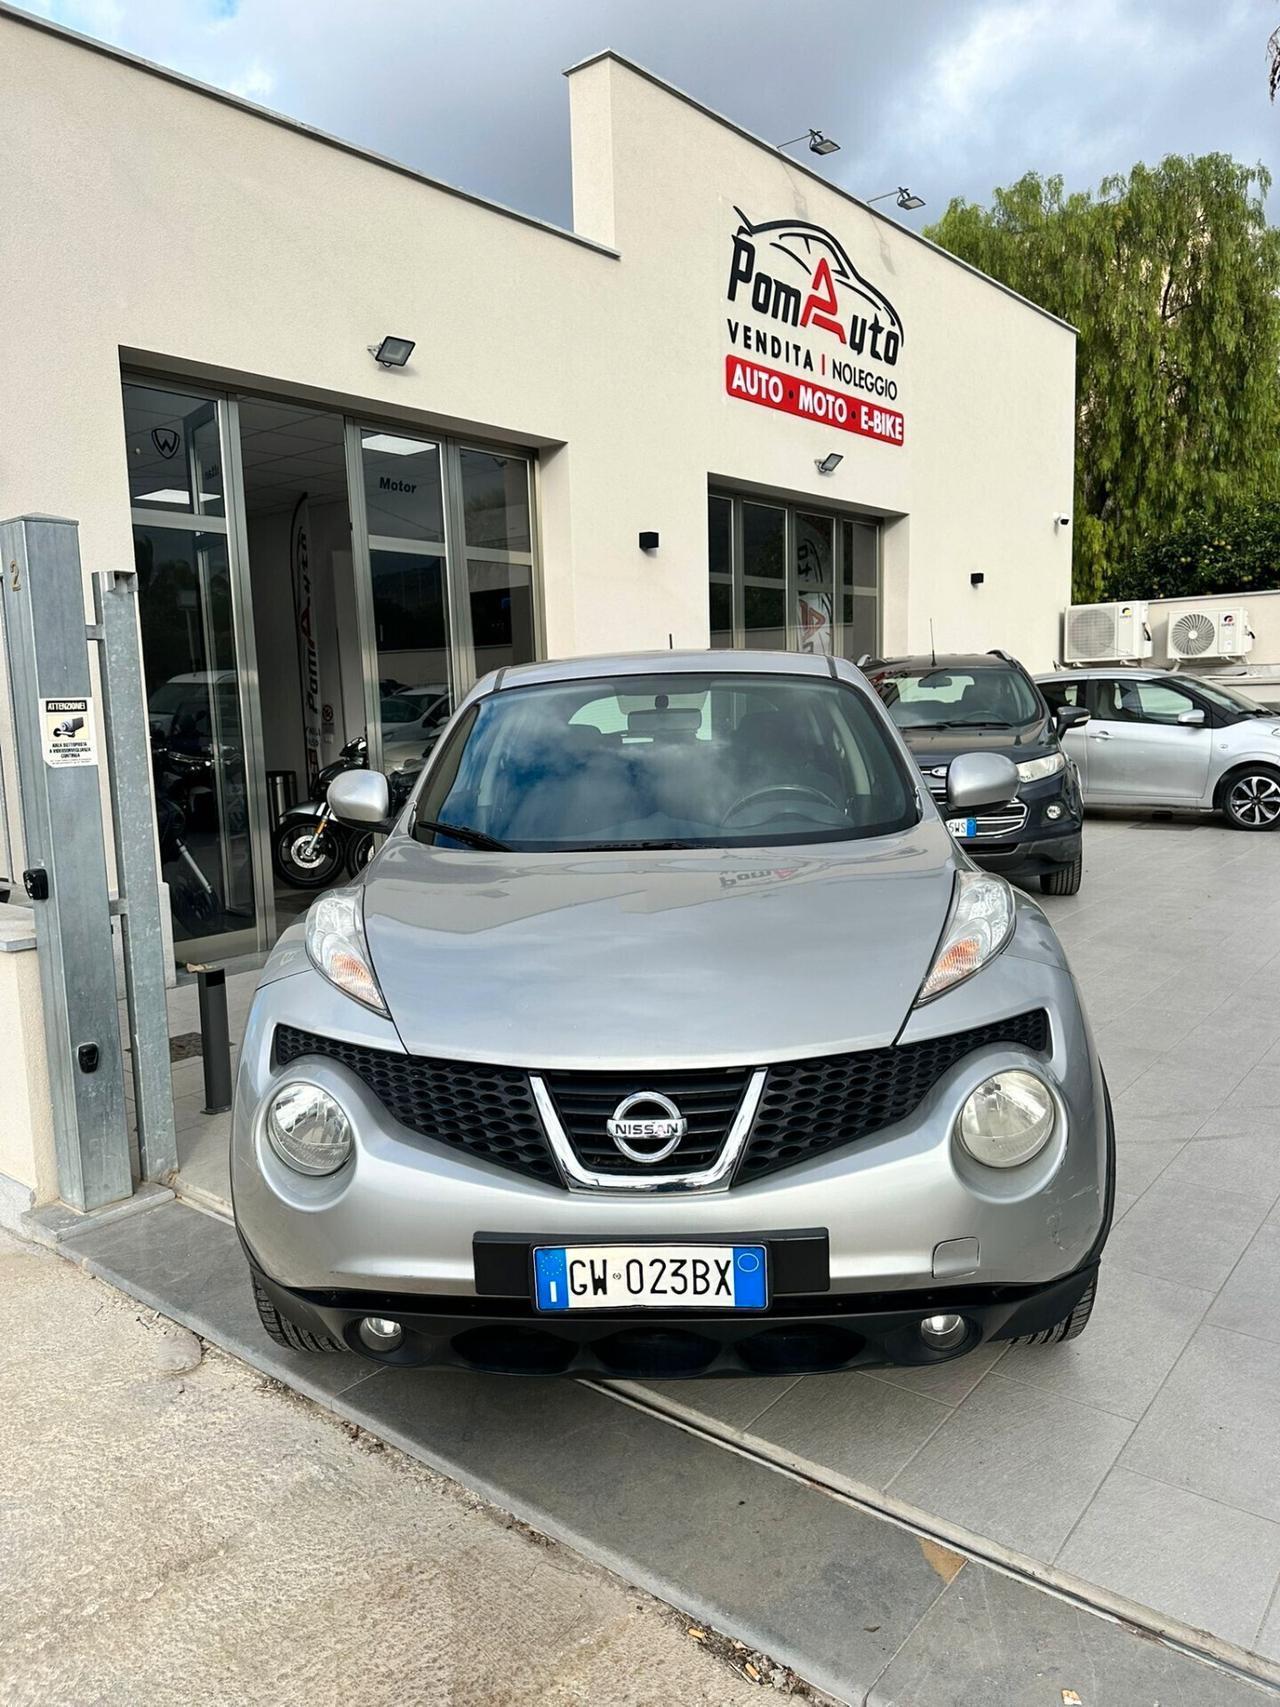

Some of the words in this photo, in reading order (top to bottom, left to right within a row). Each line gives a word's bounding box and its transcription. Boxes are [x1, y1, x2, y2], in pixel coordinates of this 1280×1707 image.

[727, 318, 814, 372] VENDITA
[832, 358, 898, 401] NOLEGGIO
[731, 363, 784, 404] AUTO
[798, 384, 847, 424] MOTO
[860, 405, 903, 440] E-BIKE
[379, 476, 417, 494] Motor
[10, 559, 21, 592] 2
[615, 1123, 679, 1136] NISSAN
[569, 1259, 608, 1296] GW
[626, 1259, 732, 1296] 023BX
